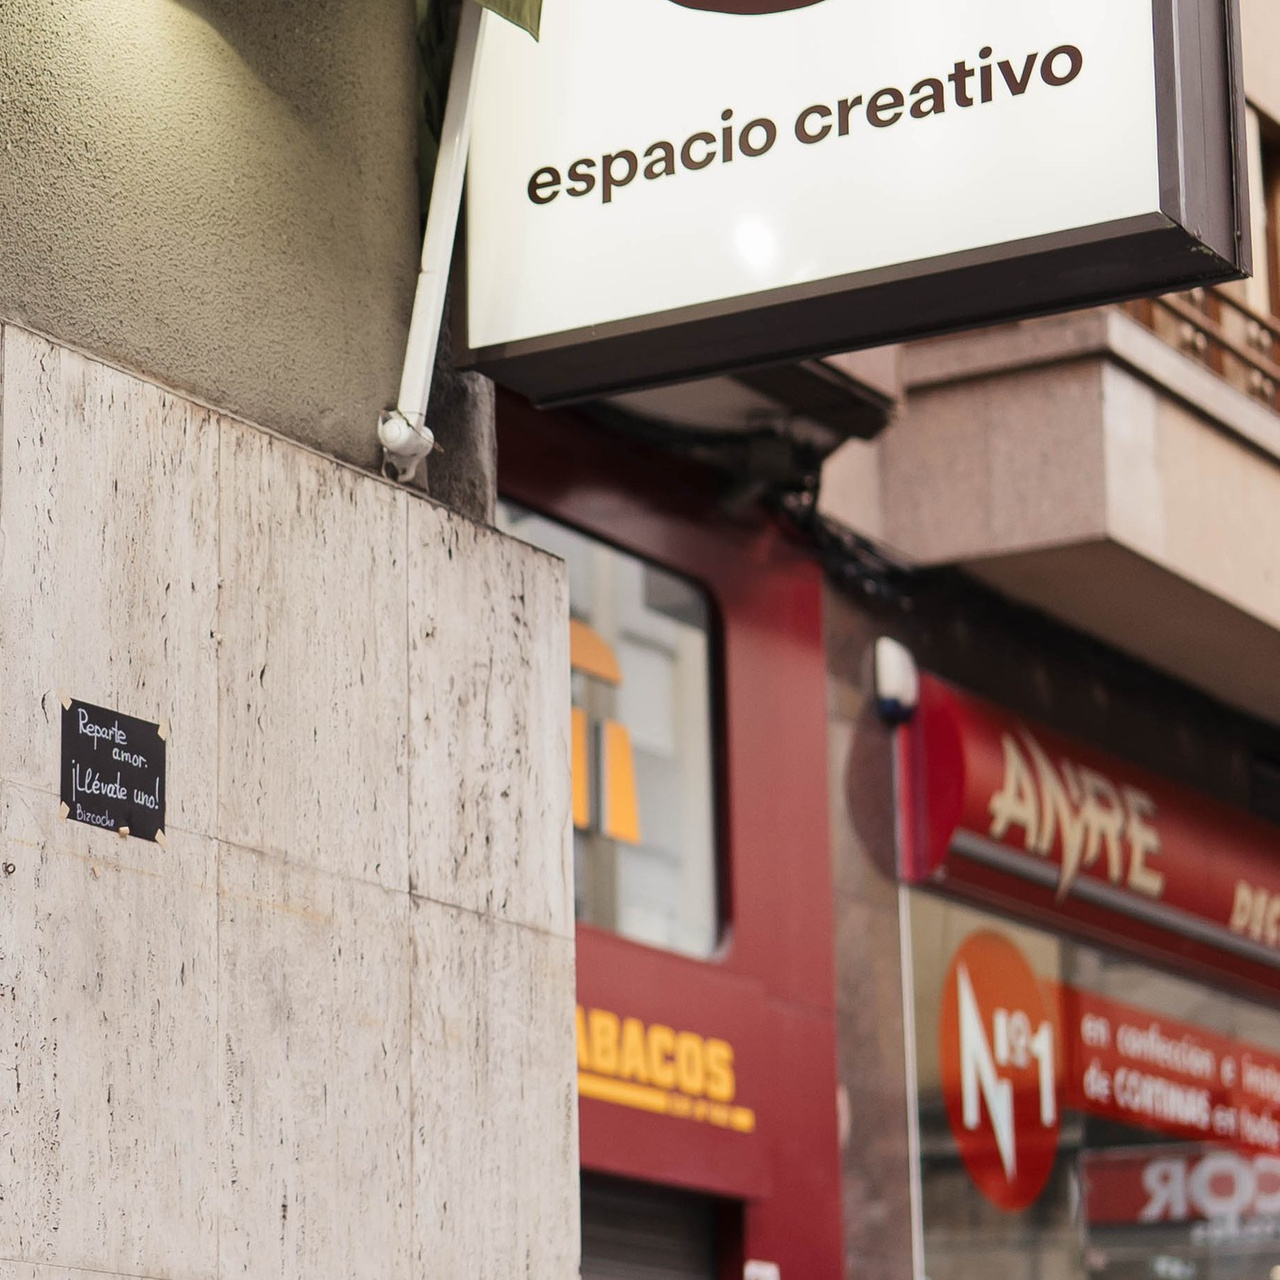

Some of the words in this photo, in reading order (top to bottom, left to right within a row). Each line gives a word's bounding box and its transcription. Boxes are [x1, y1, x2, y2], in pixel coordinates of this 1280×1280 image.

[526, 107, 778, 206] espacio
[794, 43, 1084, 143] creativo
[78, 708, 127, 750] Reparte
[112, 747, 148, 768] amor.
[71, 759, 128, 802] ¡Llévate
[133, 776, 160, 810] uno!
